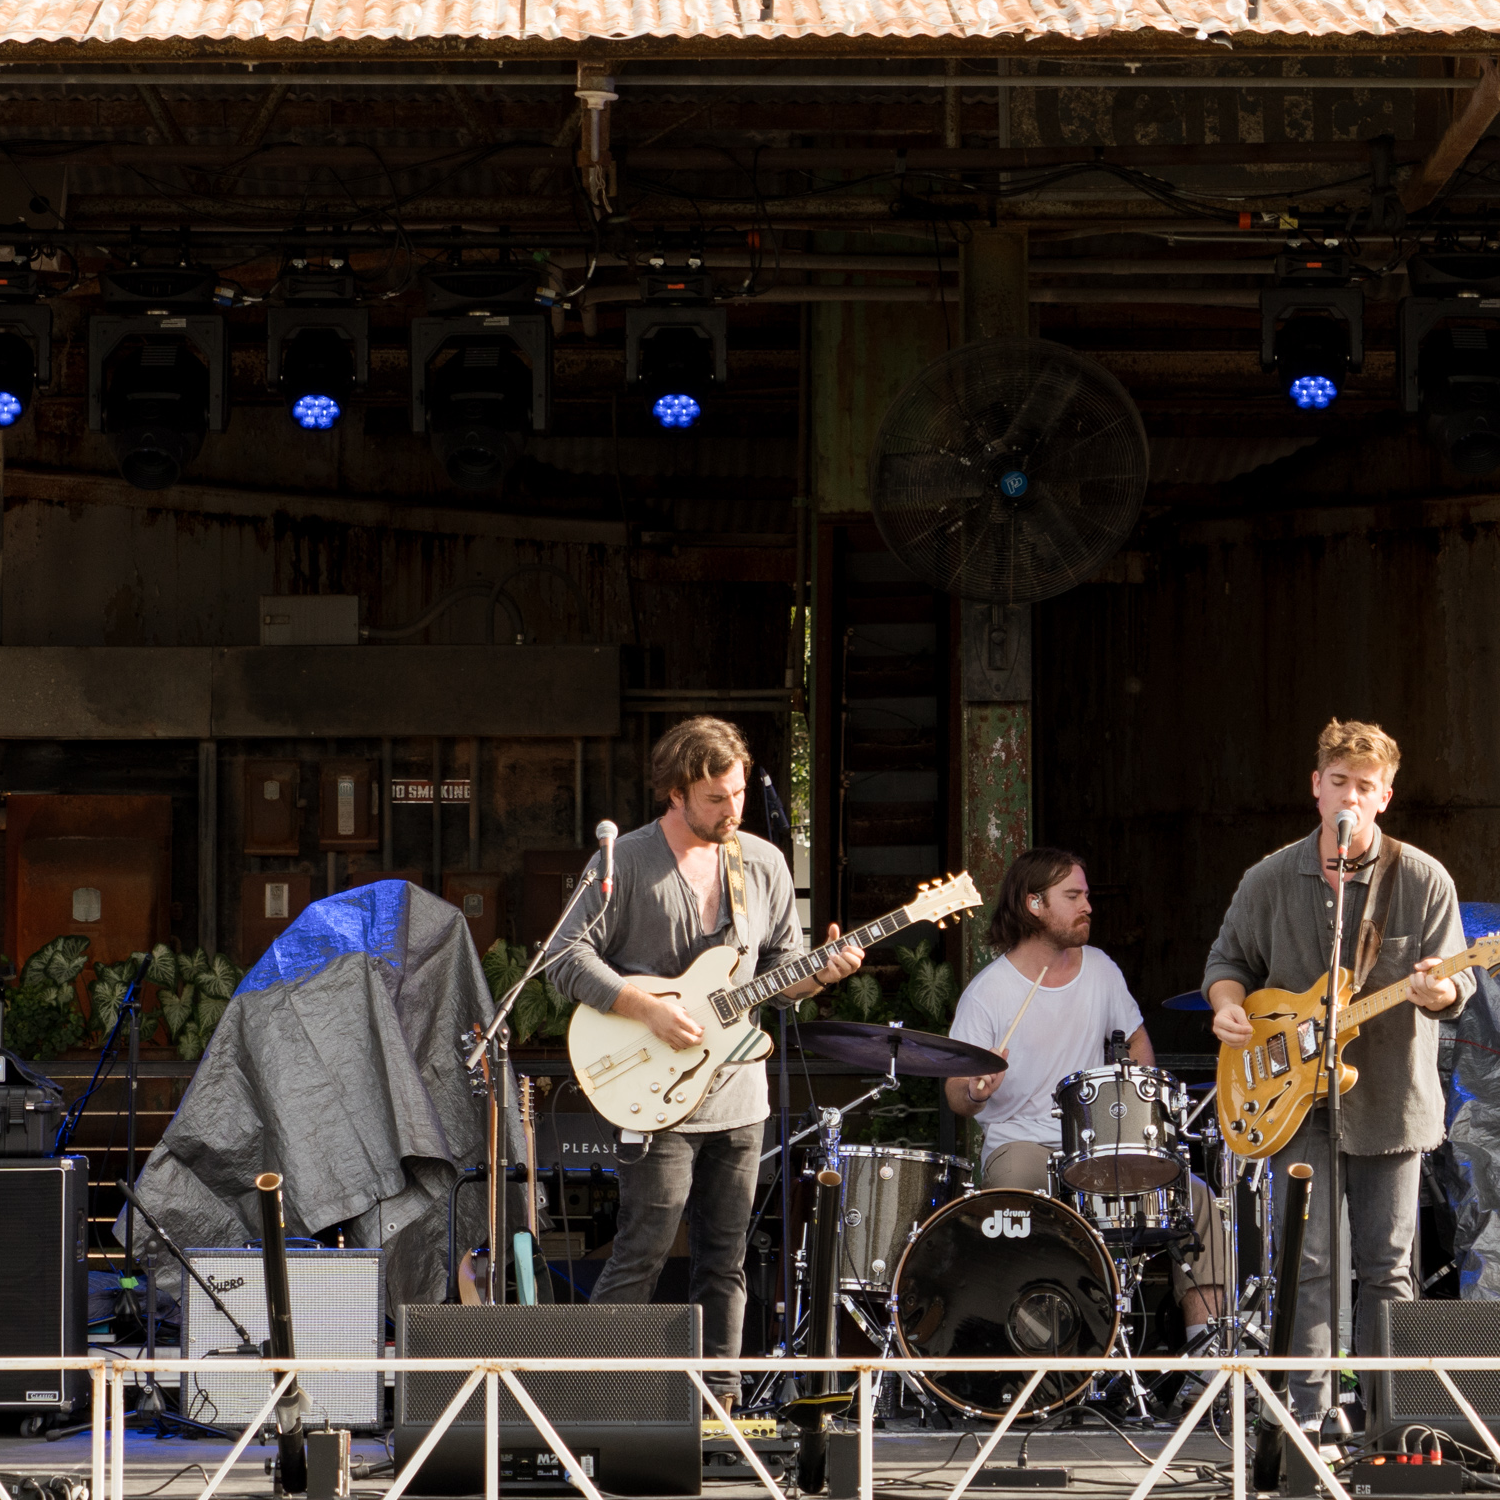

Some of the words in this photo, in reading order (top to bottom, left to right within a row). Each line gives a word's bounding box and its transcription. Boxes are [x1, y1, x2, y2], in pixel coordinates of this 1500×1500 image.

[408, 785, 471, 799] SMKING
[562, 1143, 618, 1154] PLEASE
[1003, 1208, 1031, 1217] drums
[981, 1210, 1031, 1239] dw
[536, 1453, 559, 1464] M2
